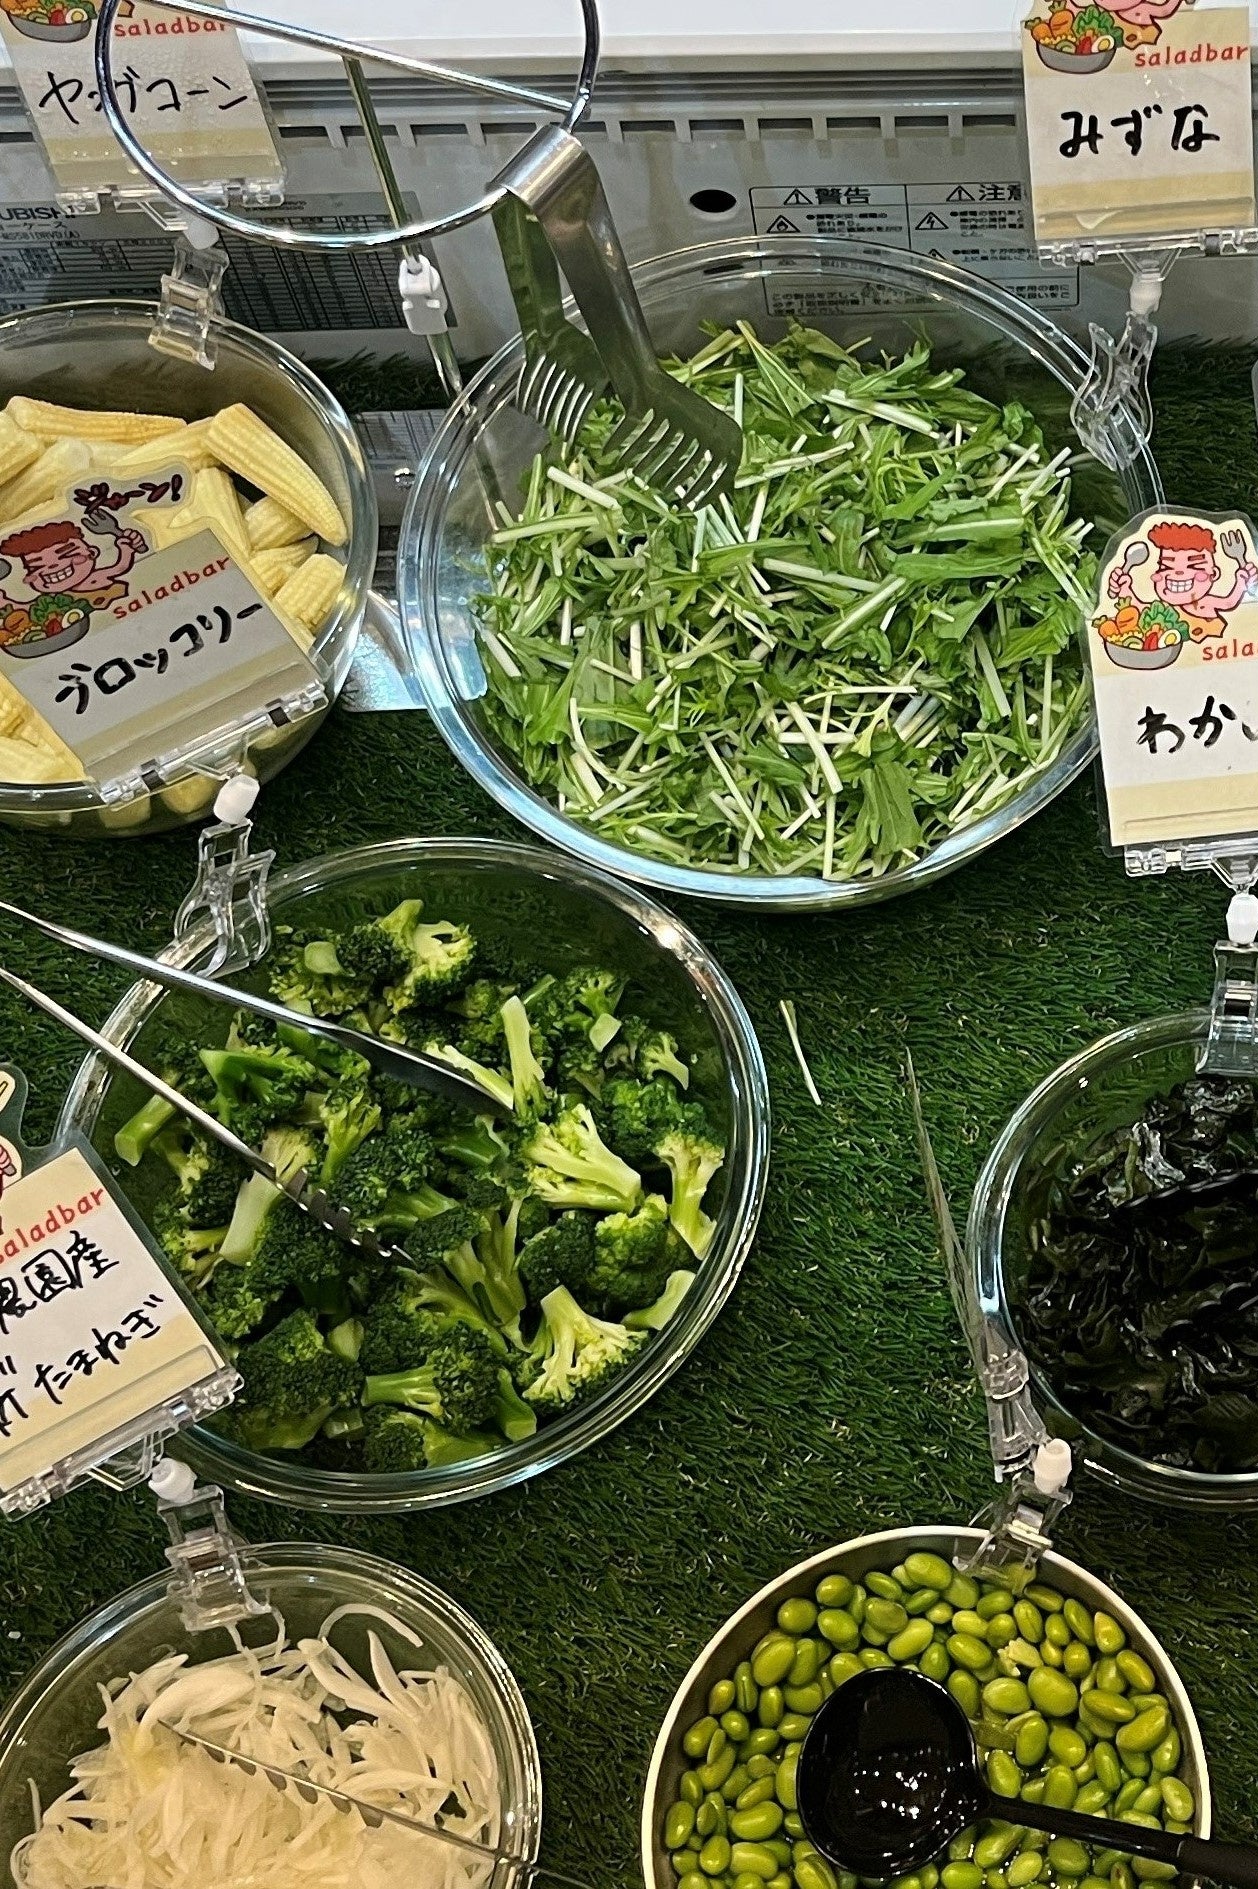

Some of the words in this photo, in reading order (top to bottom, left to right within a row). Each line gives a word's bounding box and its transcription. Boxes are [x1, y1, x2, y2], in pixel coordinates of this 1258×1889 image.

[1134, 43, 1249, 67] saladbar
[1059, 104, 1220, 157] みずな
[113, 556, 230, 620] saladbar
[55, 603, 263, 714] ブロッコリー
[0, 1188, 104, 1264] aladbar
